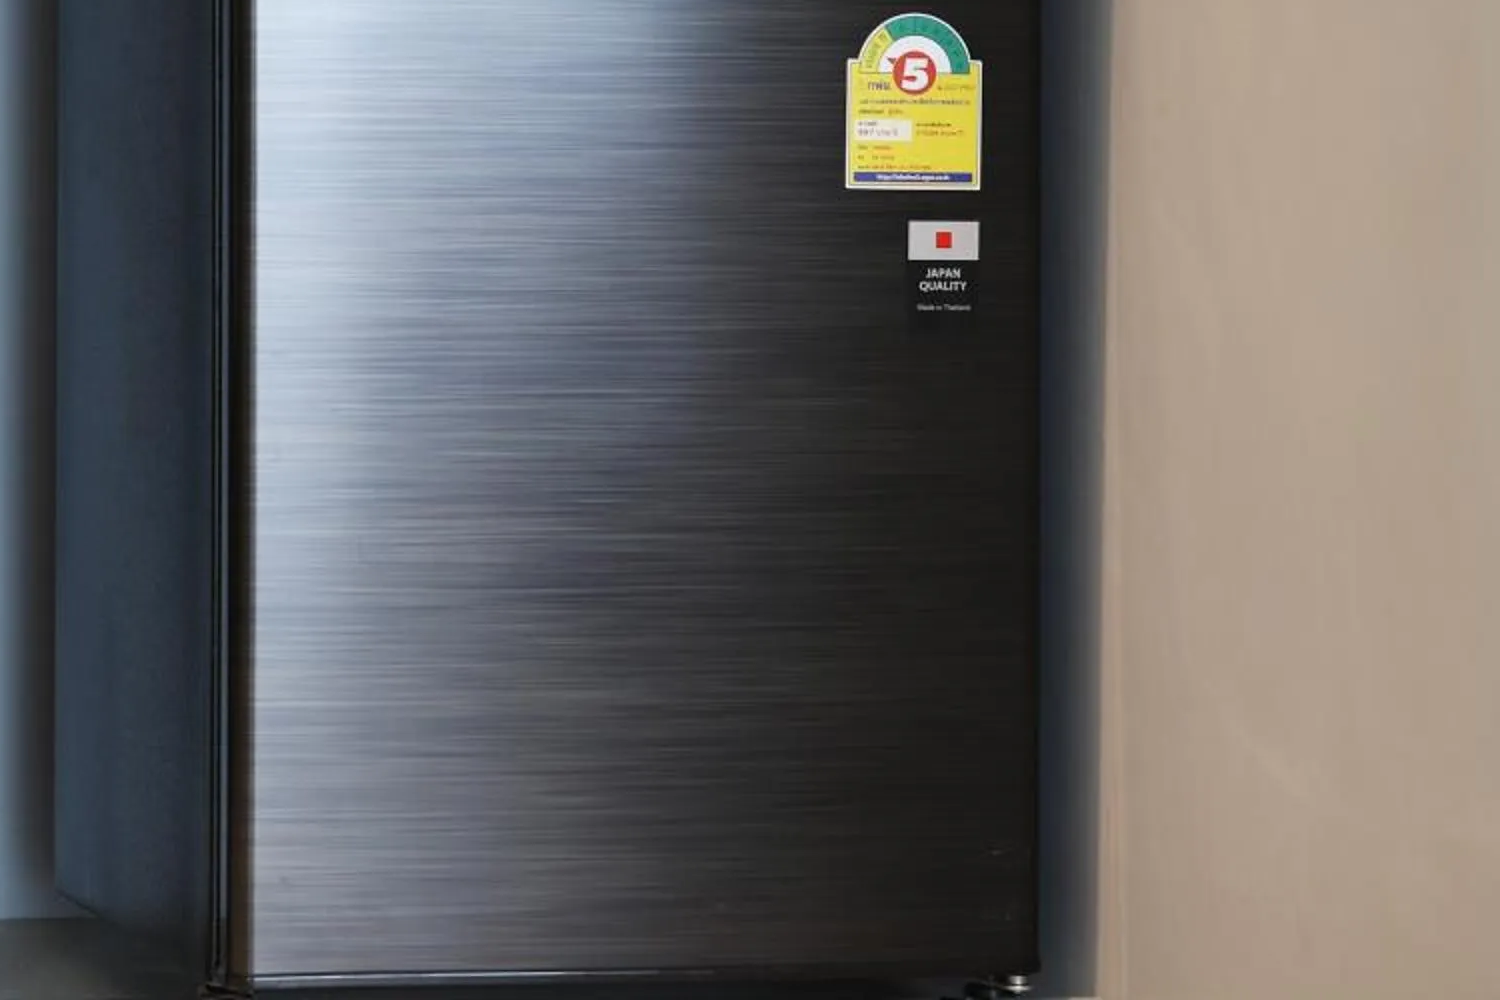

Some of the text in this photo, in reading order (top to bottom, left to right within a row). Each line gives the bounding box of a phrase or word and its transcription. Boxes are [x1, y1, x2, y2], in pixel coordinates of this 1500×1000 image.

[900, 56, 930, 92] 5
[925, 267, 961, 279] JAPAN
[919, 281, 968, 293] QUALITY
